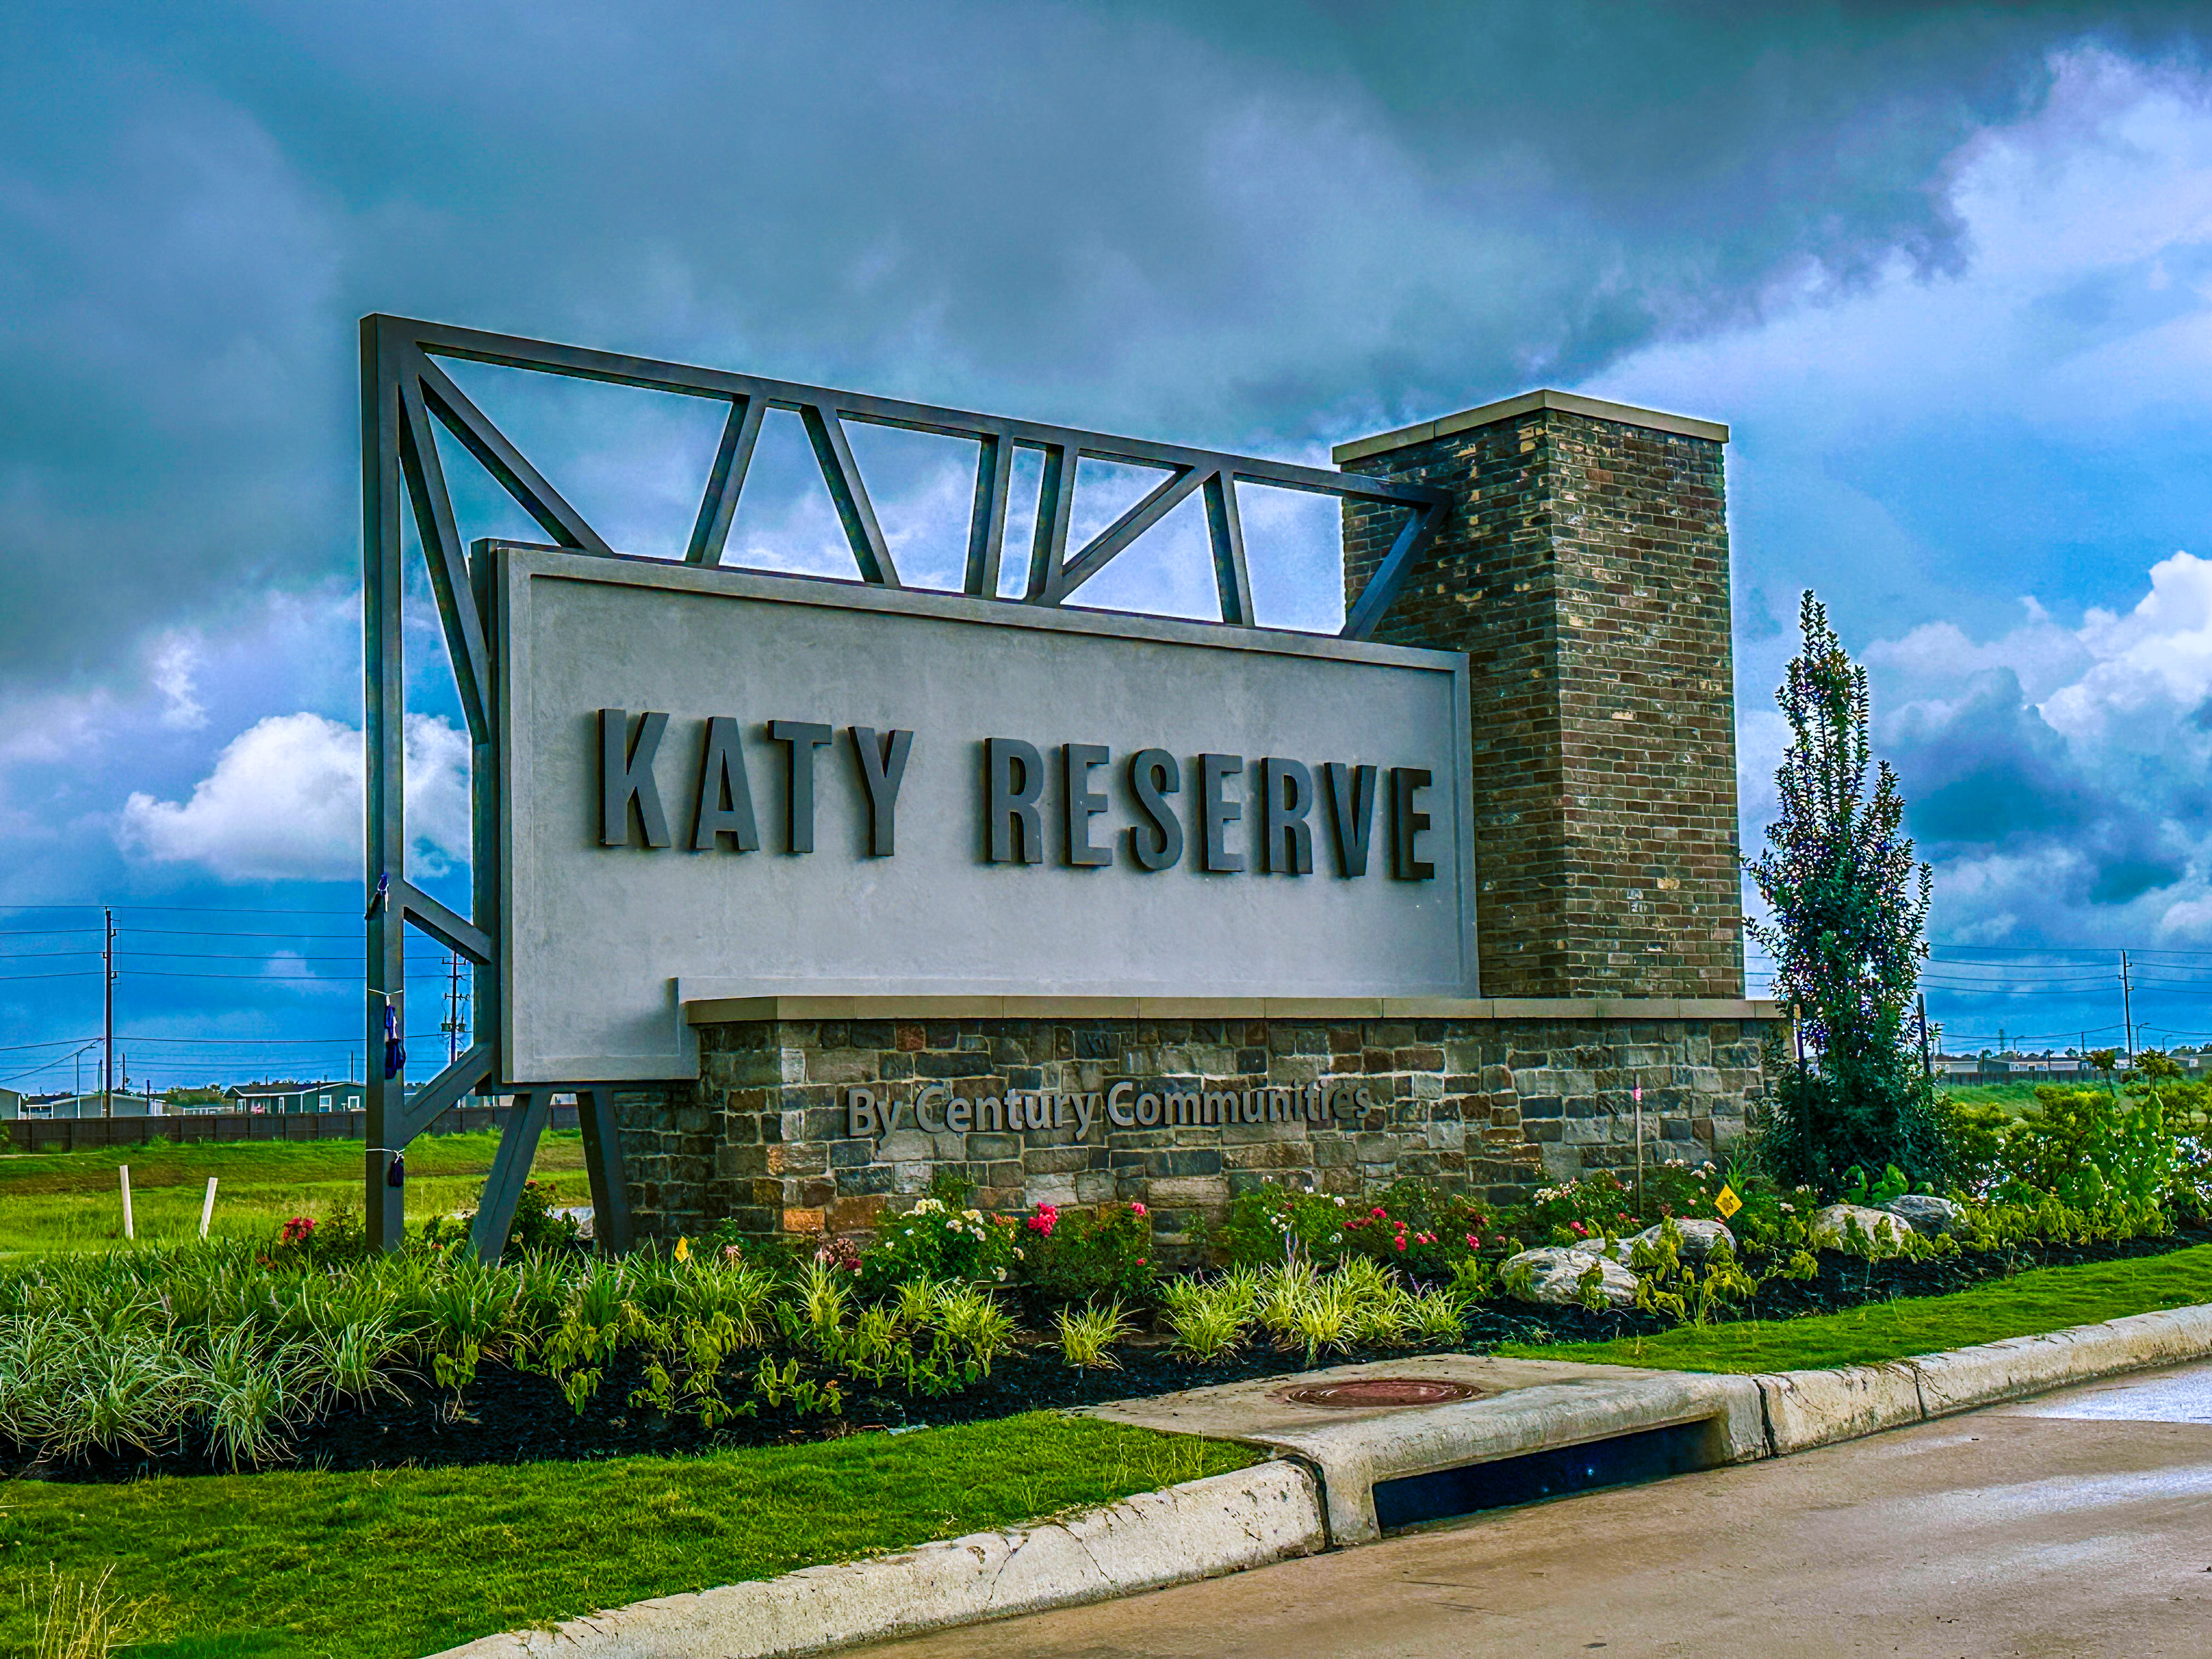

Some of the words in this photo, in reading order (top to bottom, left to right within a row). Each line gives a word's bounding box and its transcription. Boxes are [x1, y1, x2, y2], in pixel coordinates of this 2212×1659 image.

[599, 709, 913, 857] KATY
[985, 737, 1434, 879] RESERVE
[848, 1088, 903, 1149] By
[916, 1086, 1096, 1141] Century
[1108, 1080, 1372, 1126] Communities
